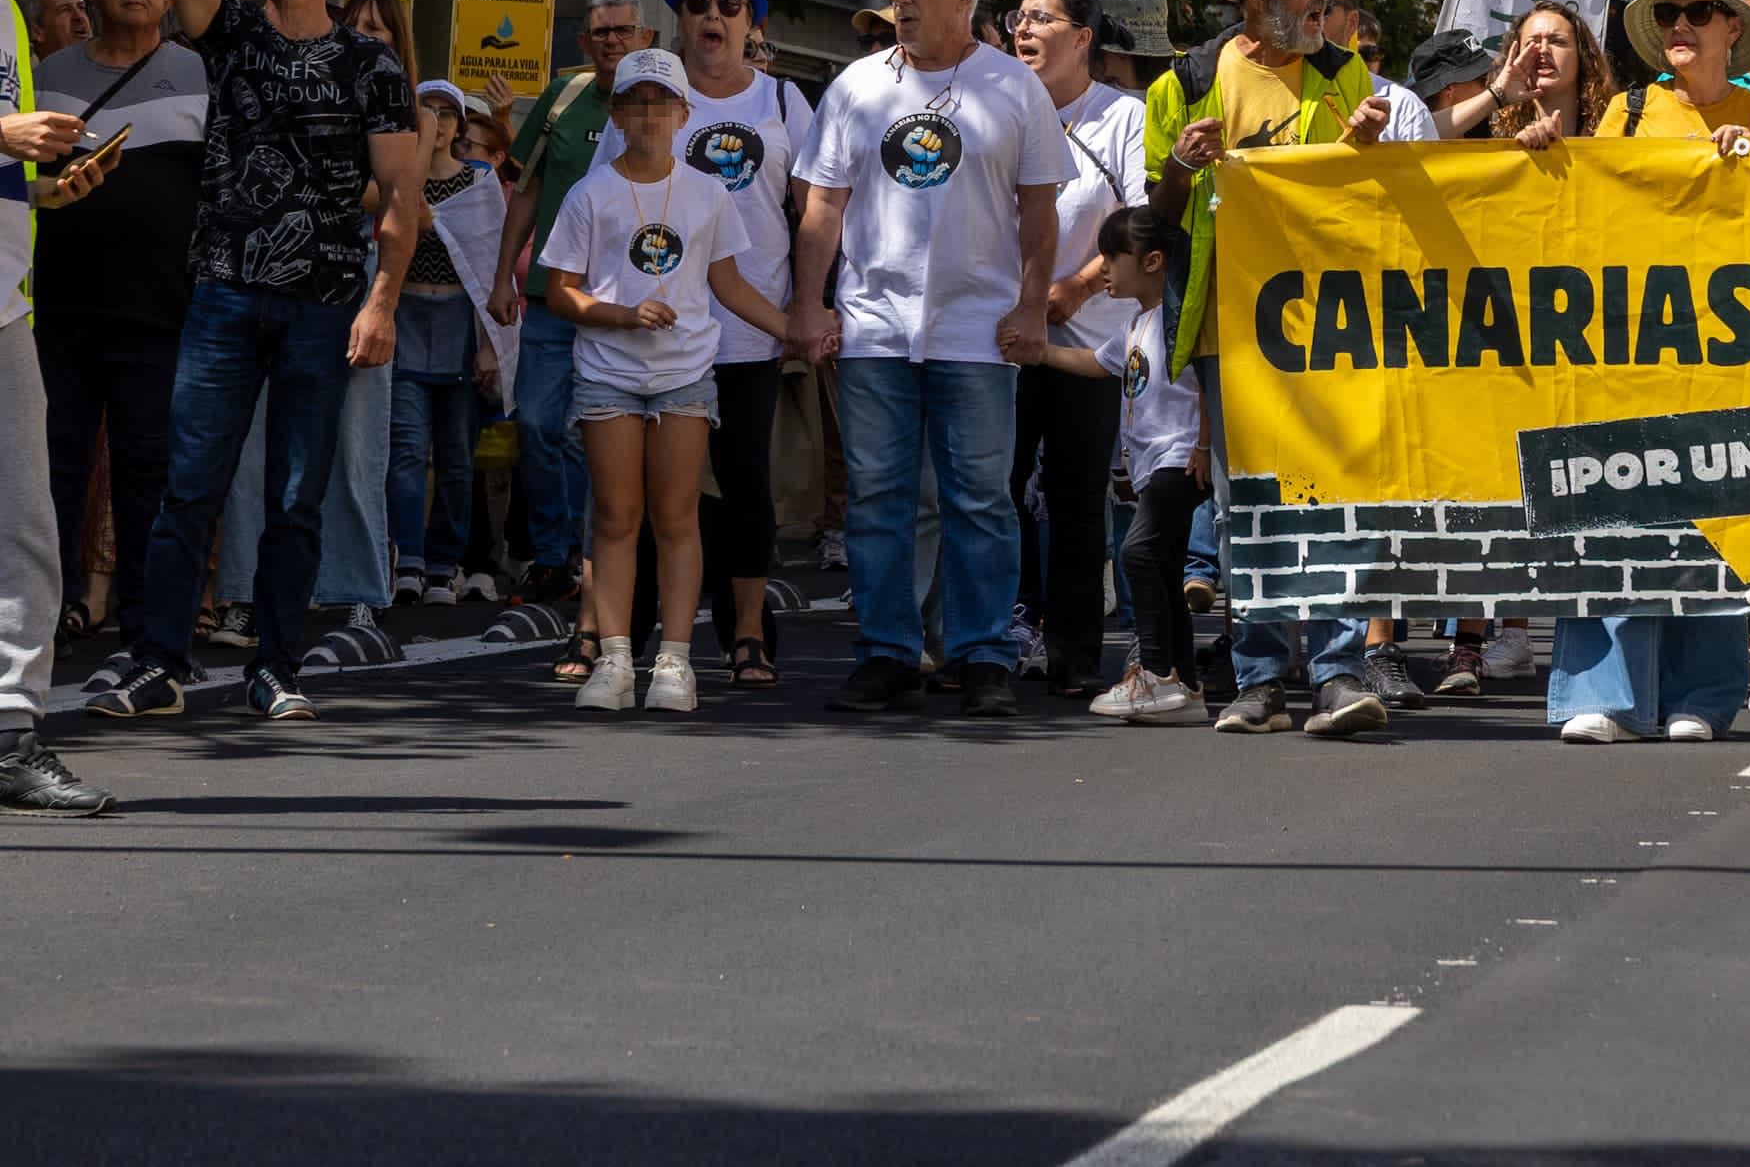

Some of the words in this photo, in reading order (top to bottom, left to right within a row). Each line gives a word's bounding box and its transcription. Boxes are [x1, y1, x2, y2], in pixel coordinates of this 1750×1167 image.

[459, 68, 470, 78] NO
[471, 69, 491, 79] PARA
[460, 55, 483, 67] AGUA
[484, 56, 505, 69] PARA
[508, 57, 519, 69] LA
[520, 58, 540, 71] VIDA
[883, 115, 916, 142] CANARIAS
[1550, 447, 1681, 497] ¡POR
